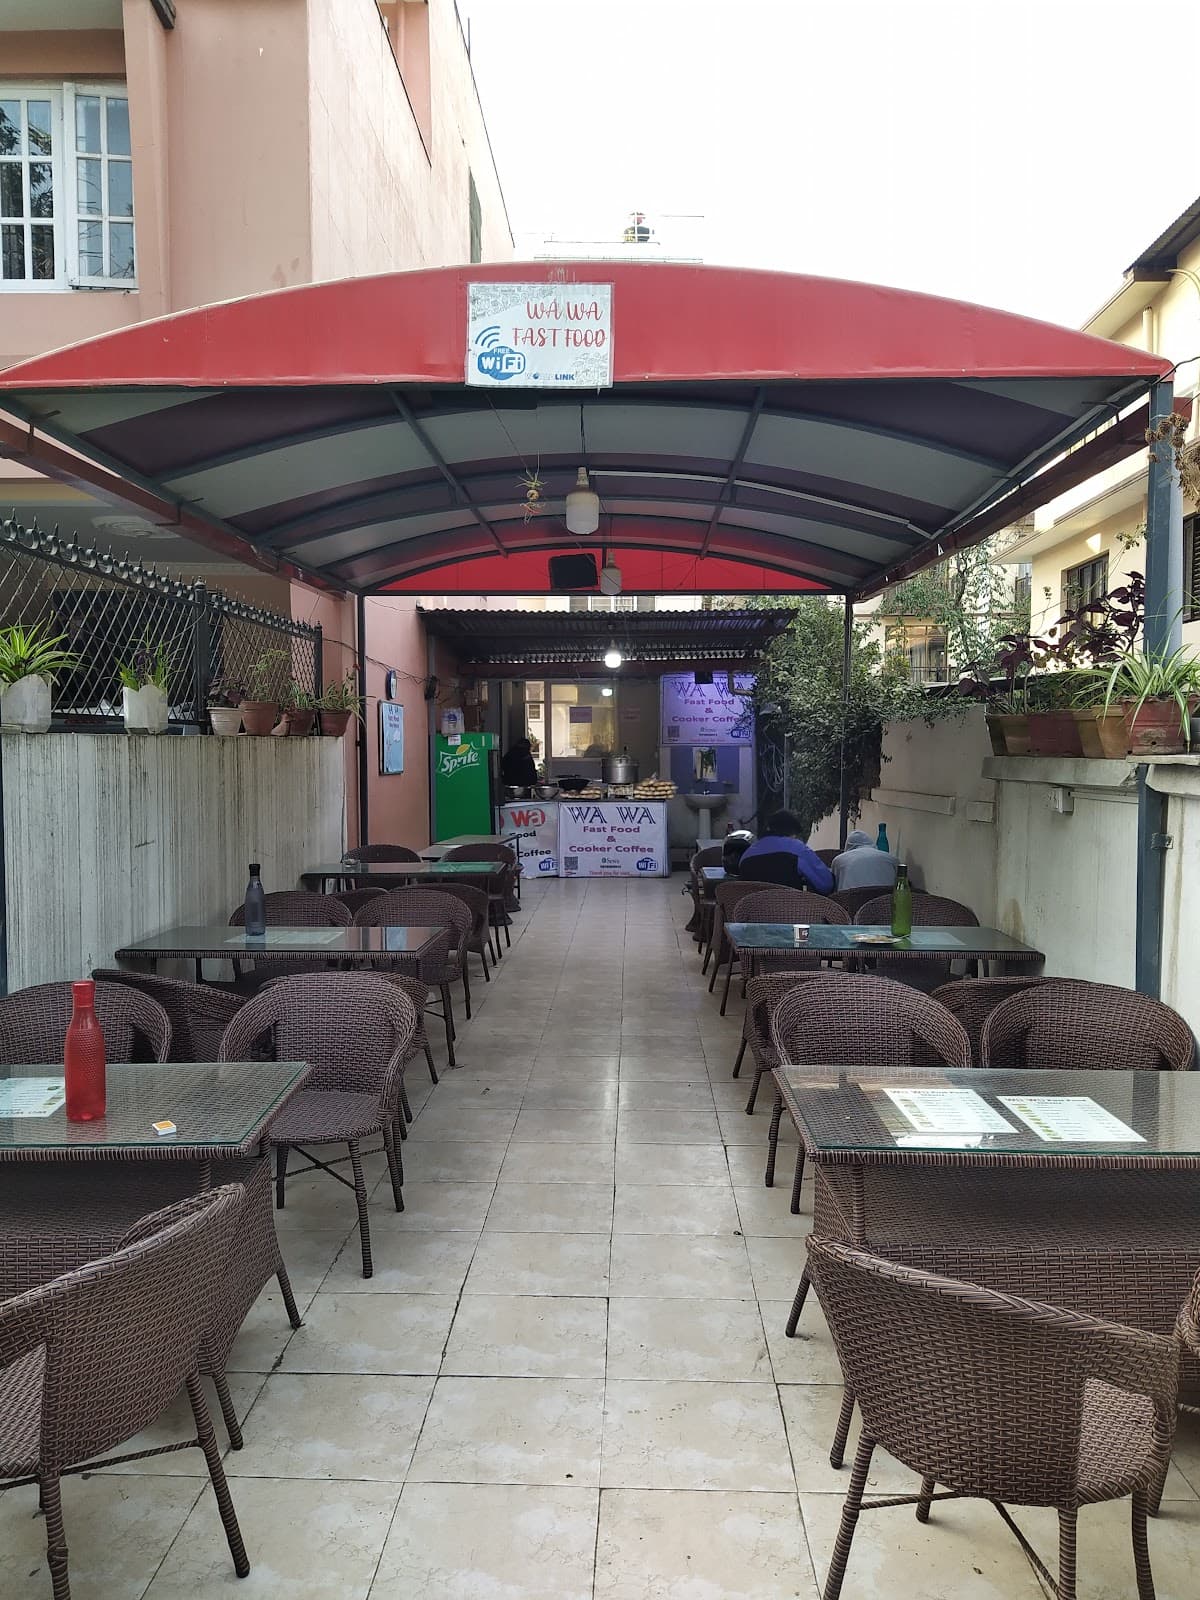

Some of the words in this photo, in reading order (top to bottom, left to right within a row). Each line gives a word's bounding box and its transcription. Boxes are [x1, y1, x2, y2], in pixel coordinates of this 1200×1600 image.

[526, 301, 562, 321] WA
[565, 301, 602, 321] WA
[512, 328, 560, 347] FAST
[564, 329, 607, 347] FOOD
[441, 751, 479, 773] Sprite
[567, 807, 608, 824] WA
[616, 807, 656, 824] WA
[569, 845, 612, 853] Cooker
[616, 845, 654, 853] Coffee
